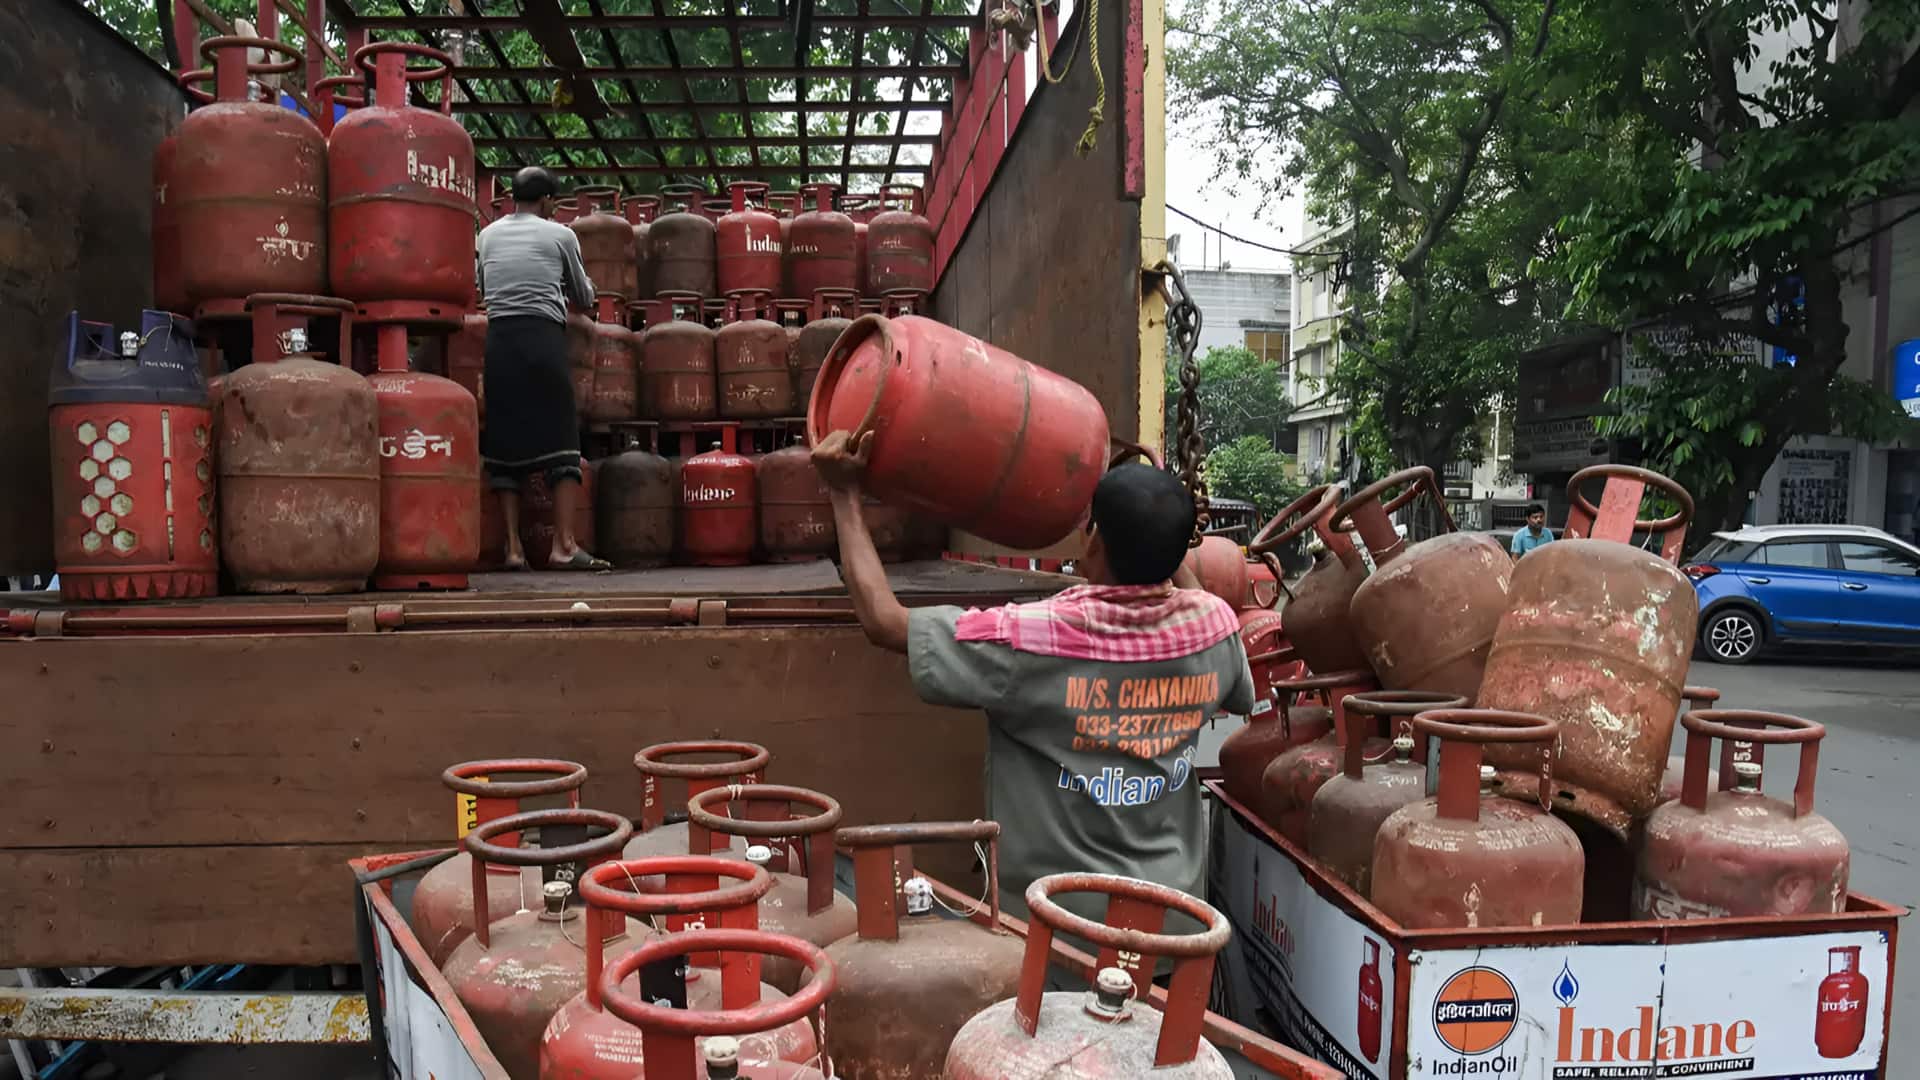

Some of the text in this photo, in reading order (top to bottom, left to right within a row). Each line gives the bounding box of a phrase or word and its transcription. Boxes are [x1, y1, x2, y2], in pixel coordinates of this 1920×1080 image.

[1065, 672, 1219, 711] M/S. CHAYANIKA
[1554, 1005, 1756, 1062] Indane
[1433, 1056, 1517, 1075] IndianOil
[1556, 1067, 1595, 1078] SAFE,
[1672, 1059, 1752, 1075] CONVENIENT
